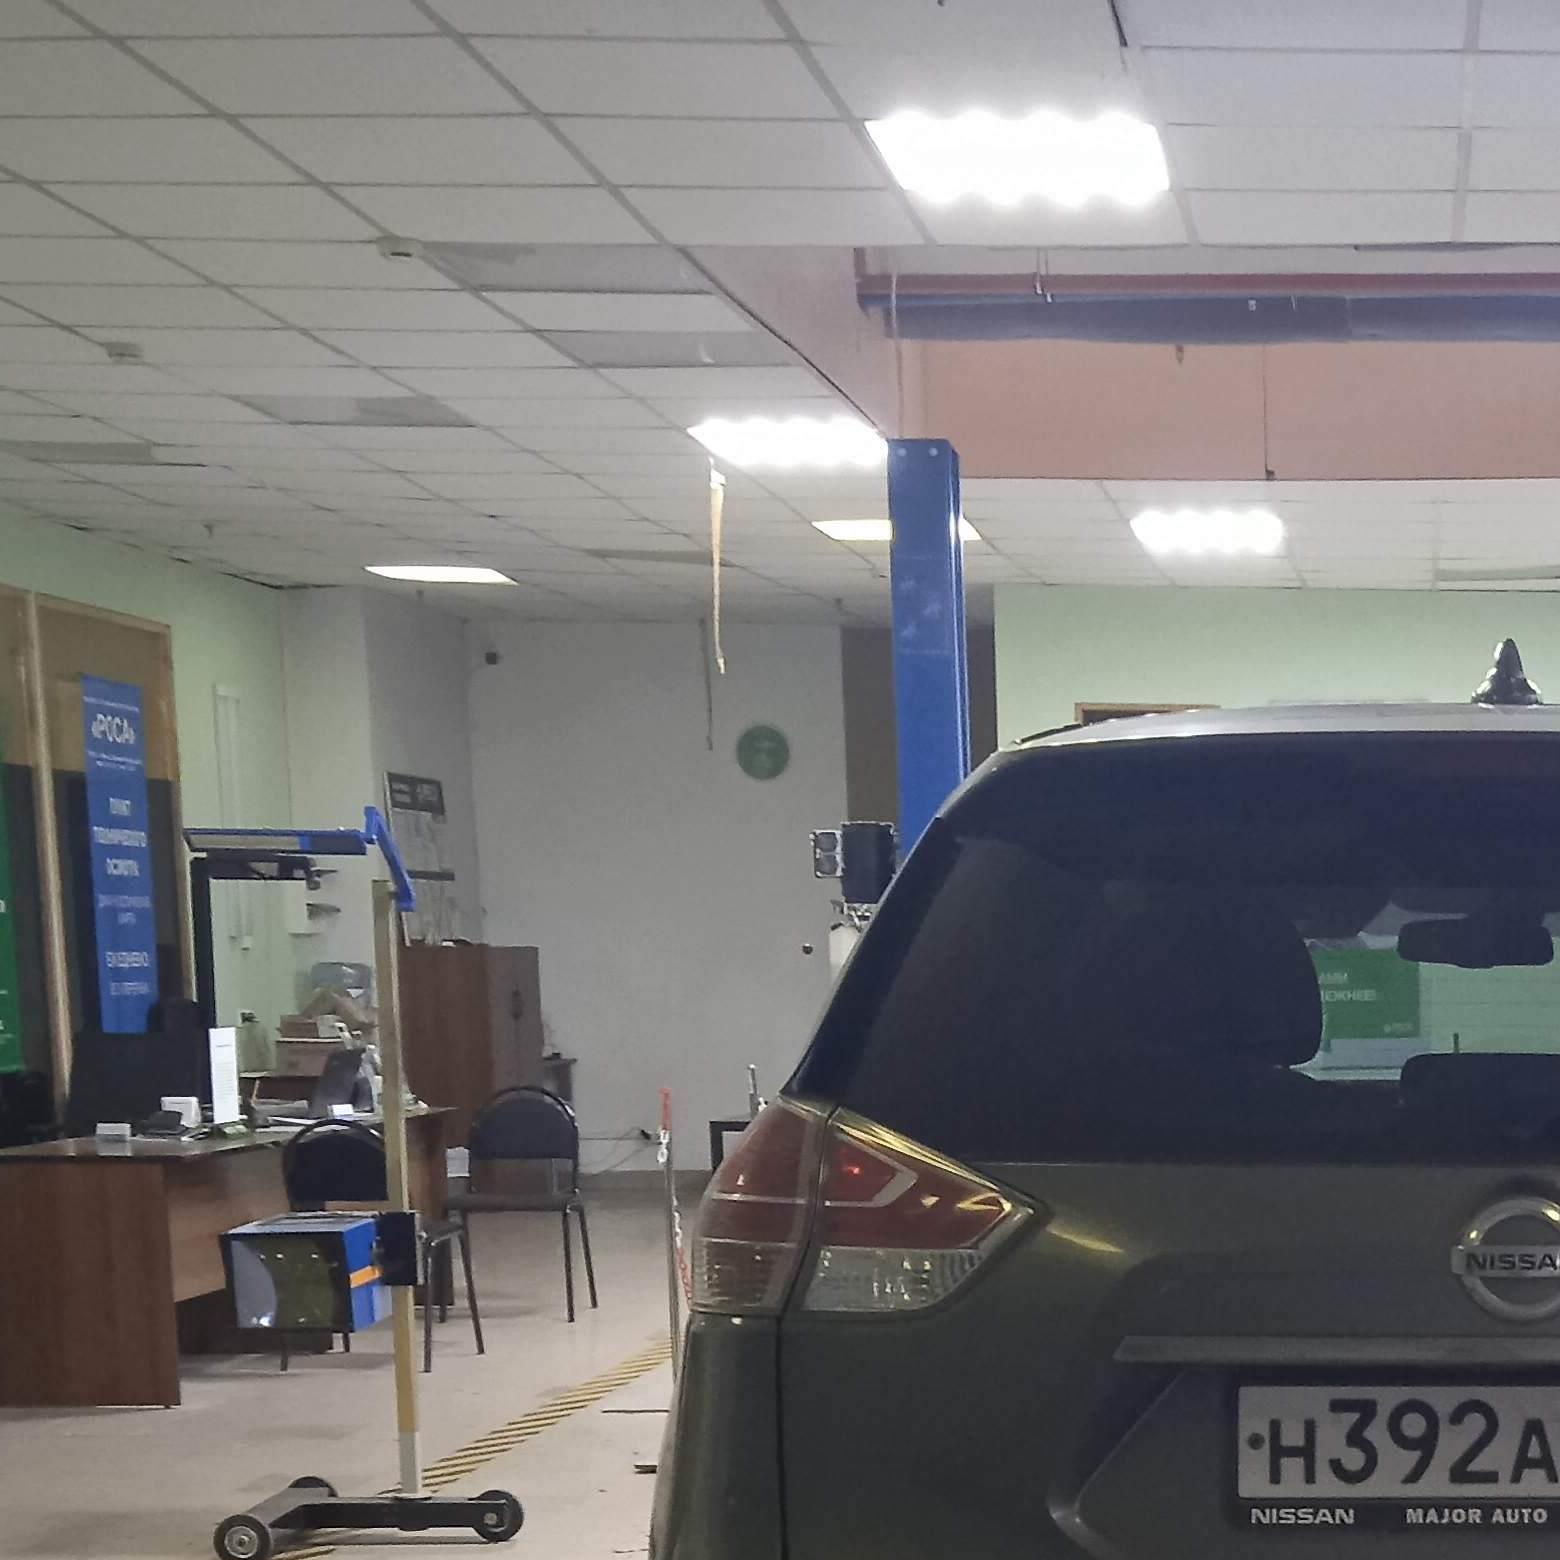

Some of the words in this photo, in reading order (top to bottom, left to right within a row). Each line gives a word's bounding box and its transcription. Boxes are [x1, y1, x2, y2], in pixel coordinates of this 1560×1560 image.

[1251, 1508, 1355, 1525] NISSAN
[1406, 1508, 1482, 1525] MAJOR
[1491, 1508, 1548, 1525] AUTO
